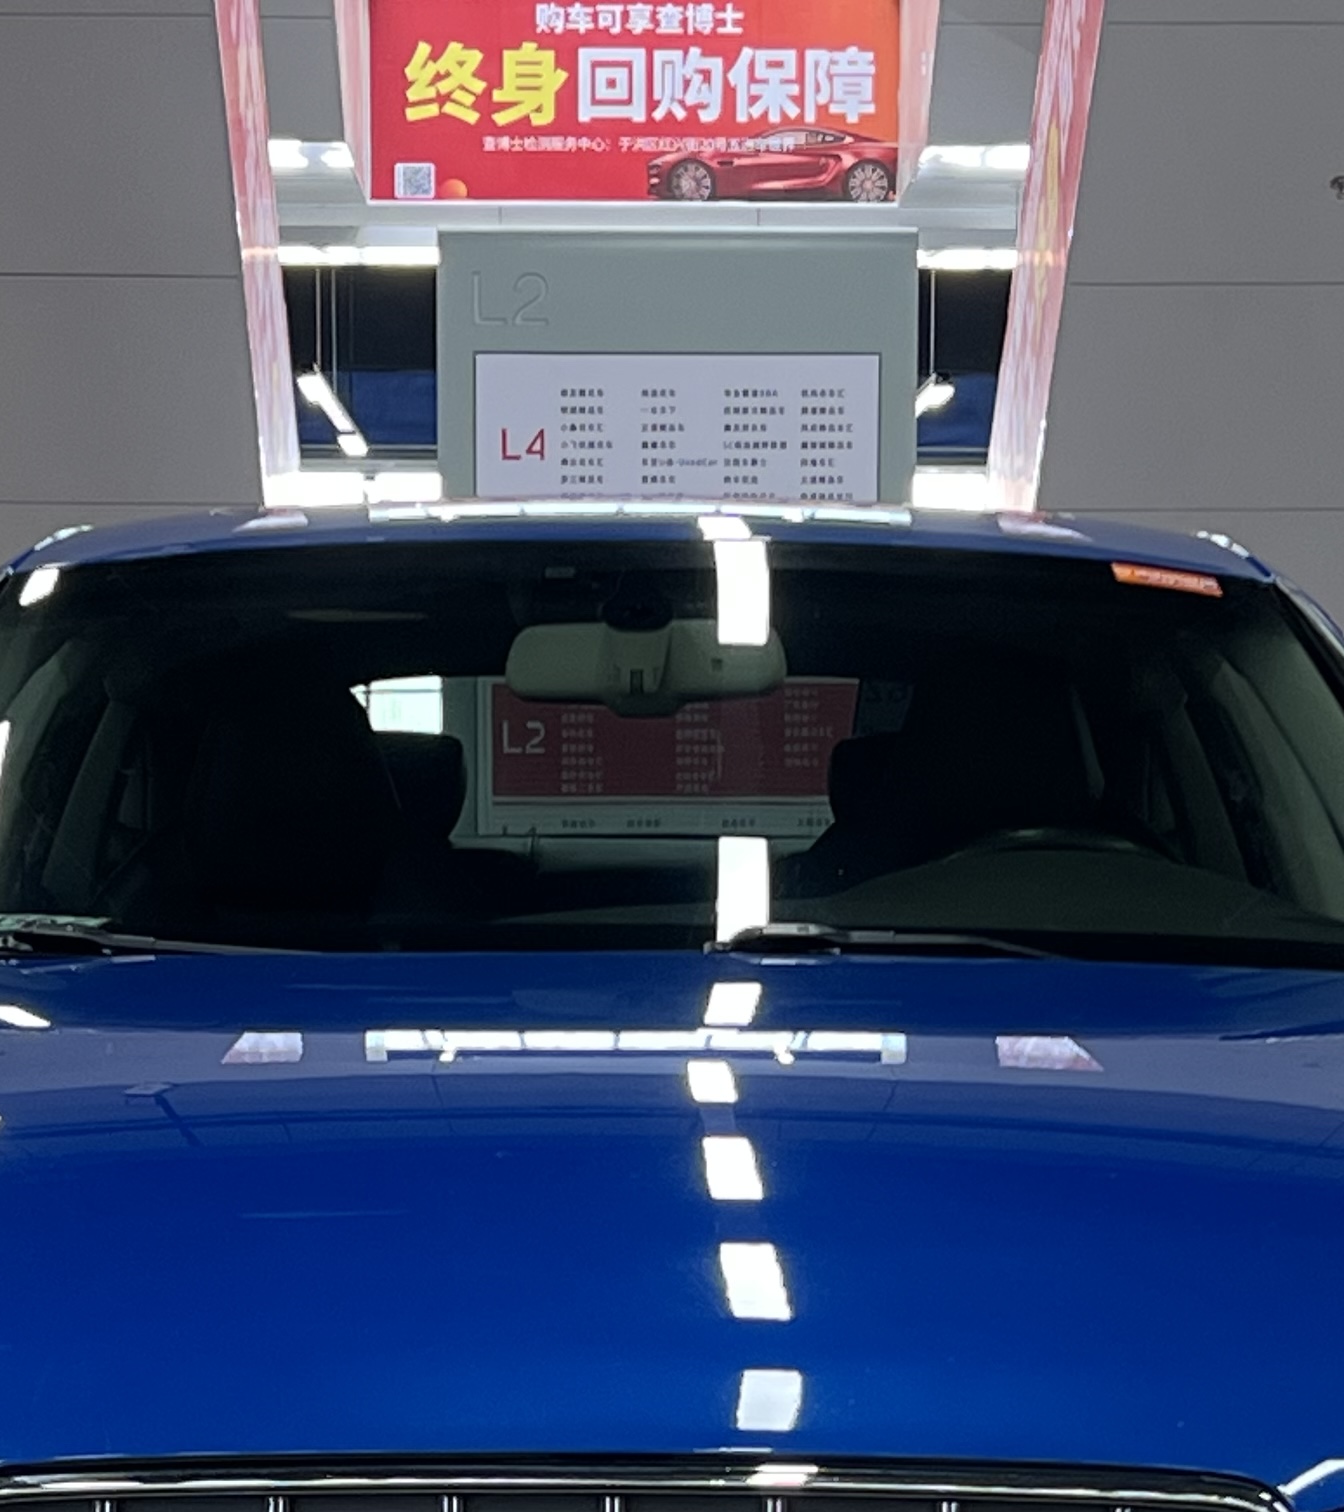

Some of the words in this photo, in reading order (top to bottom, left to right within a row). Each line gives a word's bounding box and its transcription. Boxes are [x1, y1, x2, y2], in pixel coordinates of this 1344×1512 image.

[535, 2, 745, 35] 购车可享查博士
[404, 40, 876, 127] 终身回购保障
[473, 272, 550, 327] L2
[502, 428, 547, 461] L4
[502, 719, 547, 754] L2
